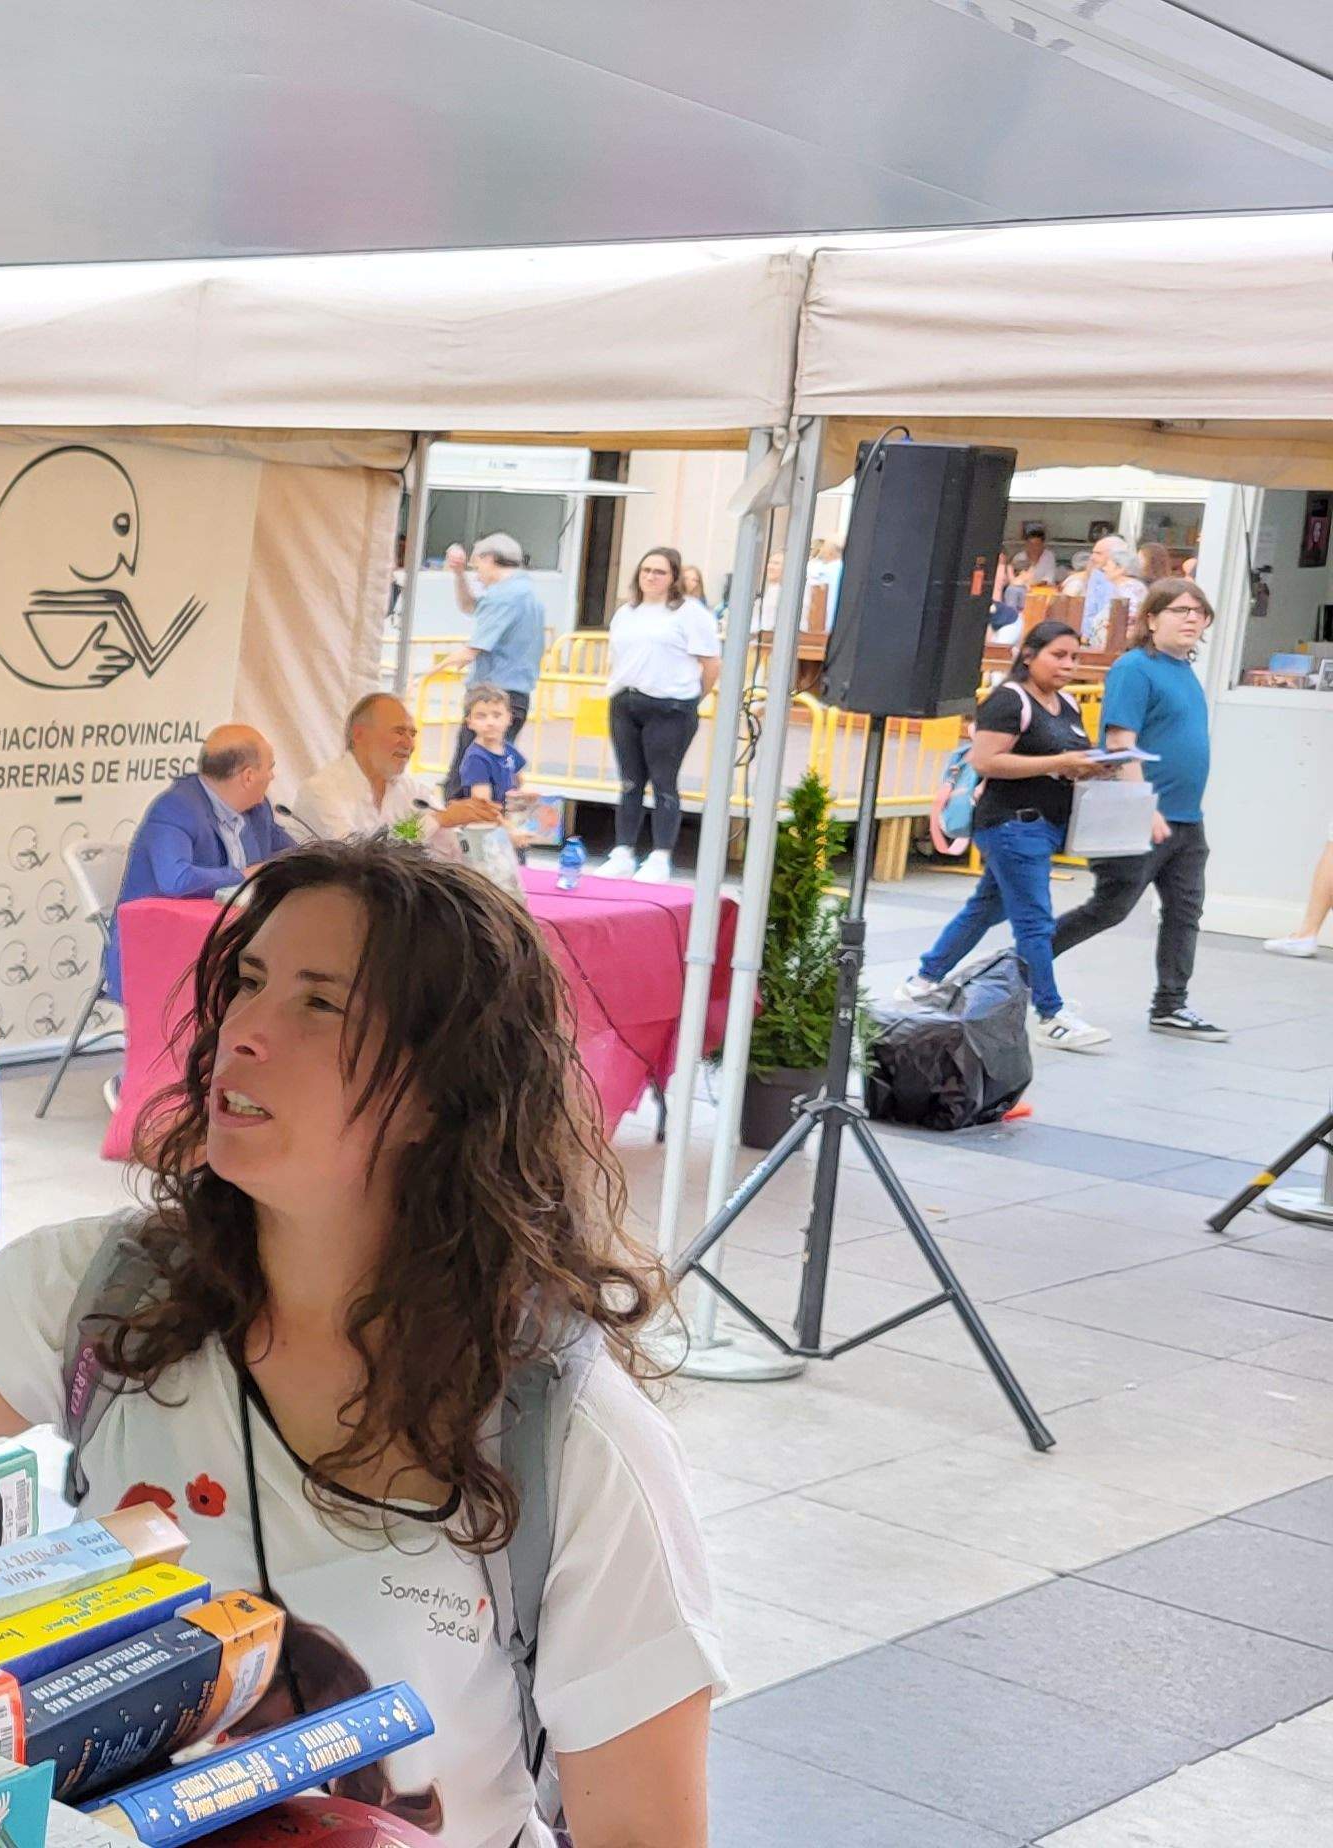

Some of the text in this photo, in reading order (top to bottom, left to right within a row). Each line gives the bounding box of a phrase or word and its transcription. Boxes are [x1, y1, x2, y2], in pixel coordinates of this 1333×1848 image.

[81, 719, 205, 748] PROVINCIAL
[91, 759, 120, 785] DE
[127, 757, 201, 782] HUESC
[379, 1574, 471, 1618] Something
[426, 1611, 481, 1643] Special
[31, 1641, 151, 1700] ESTRELLAS QUE CONTAR
[44, 1650, 171, 1714] CUANDO NO QUEDEN MÁS
[305, 1735, 361, 1771] SANDERSON
